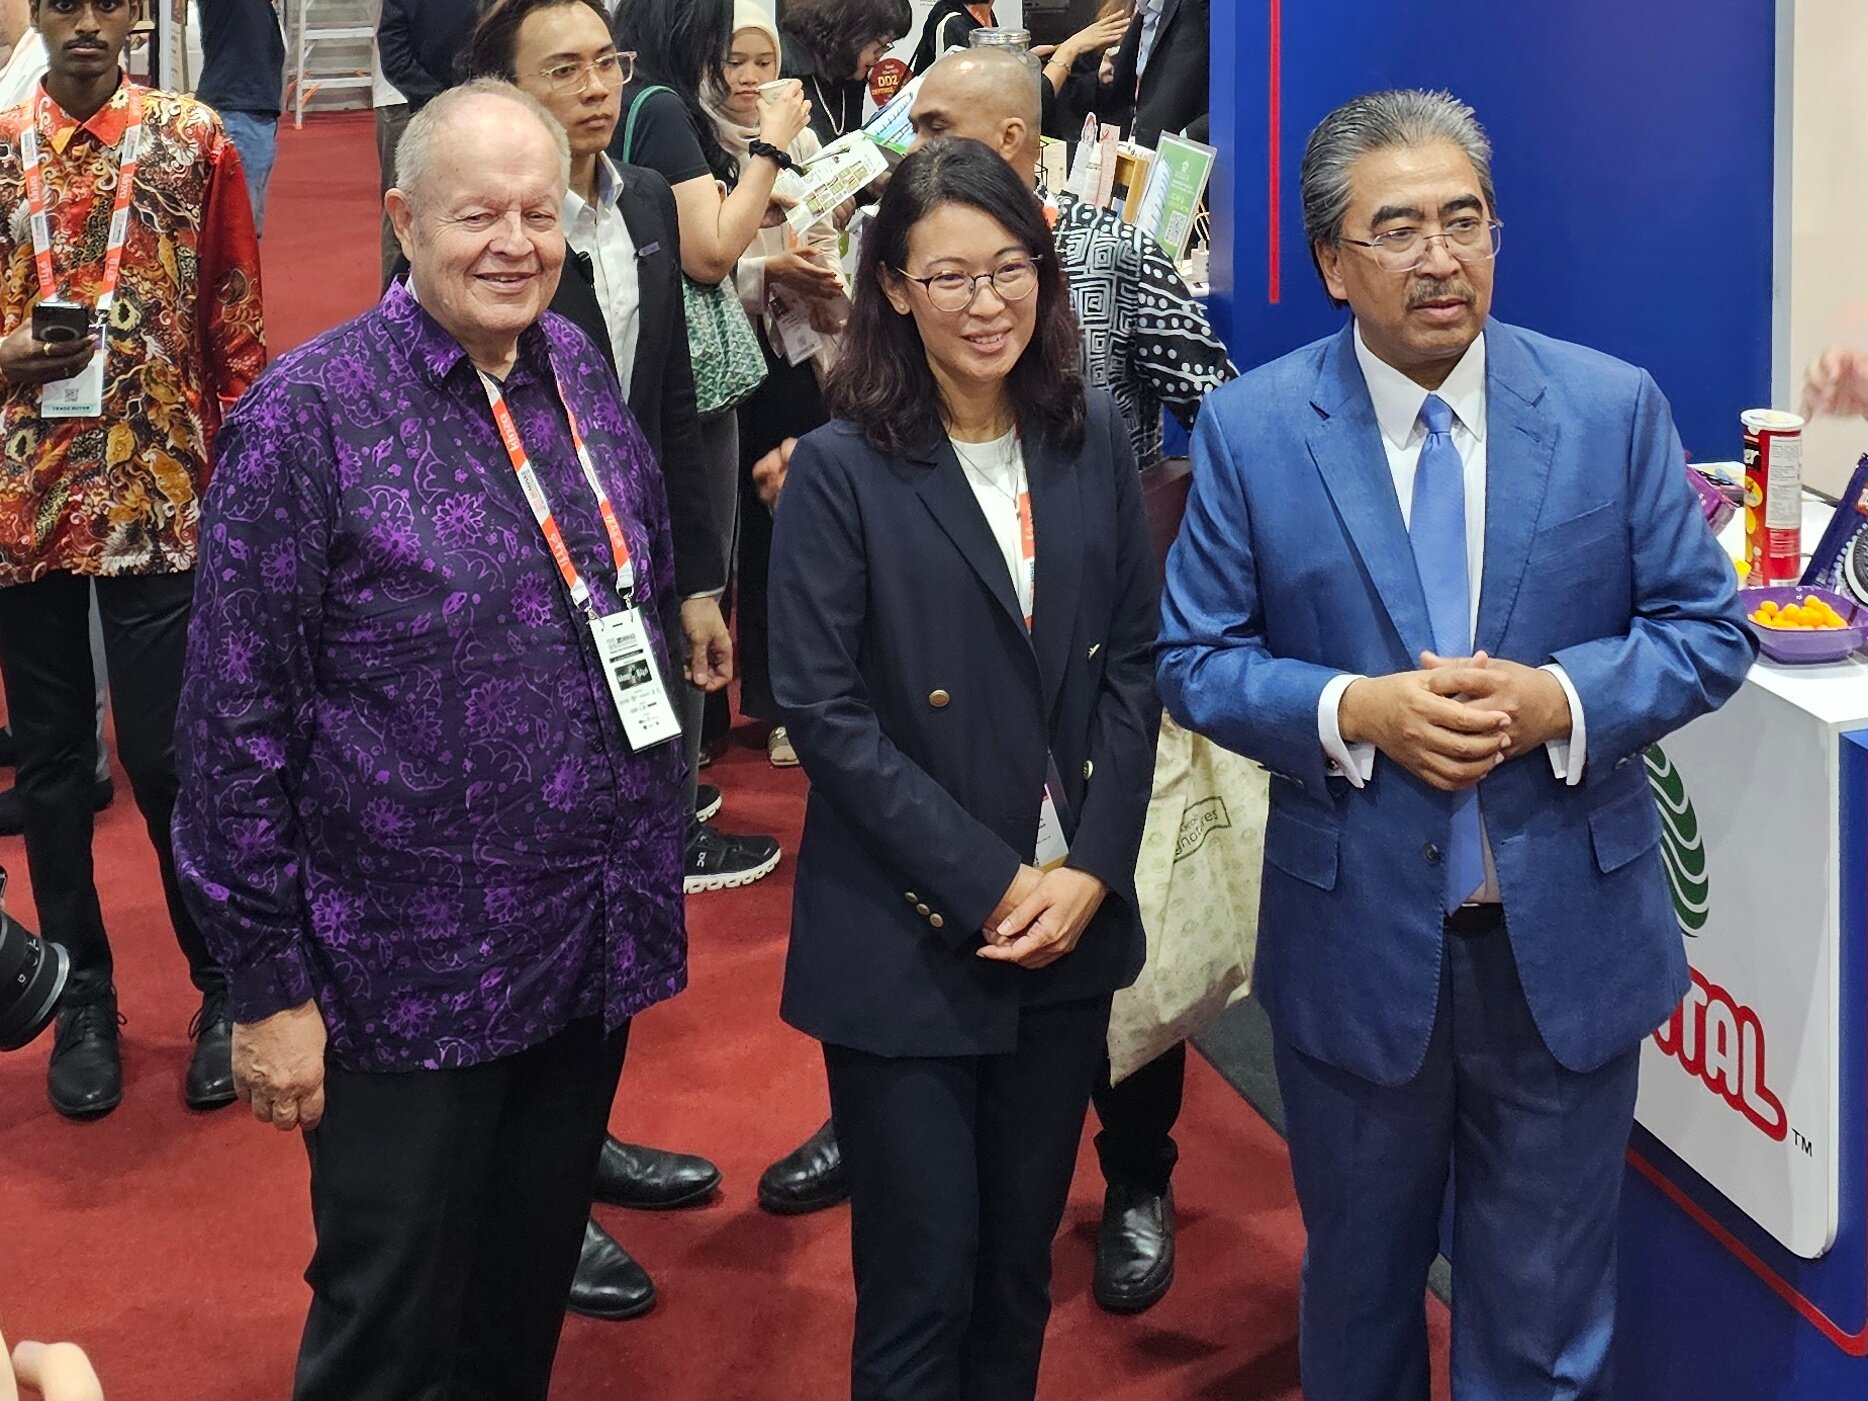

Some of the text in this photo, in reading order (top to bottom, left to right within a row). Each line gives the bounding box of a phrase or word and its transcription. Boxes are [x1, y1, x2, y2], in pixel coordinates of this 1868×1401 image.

[499, 413, 520, 452] kinza
[1655, 974, 1813, 1157] TAL TM
